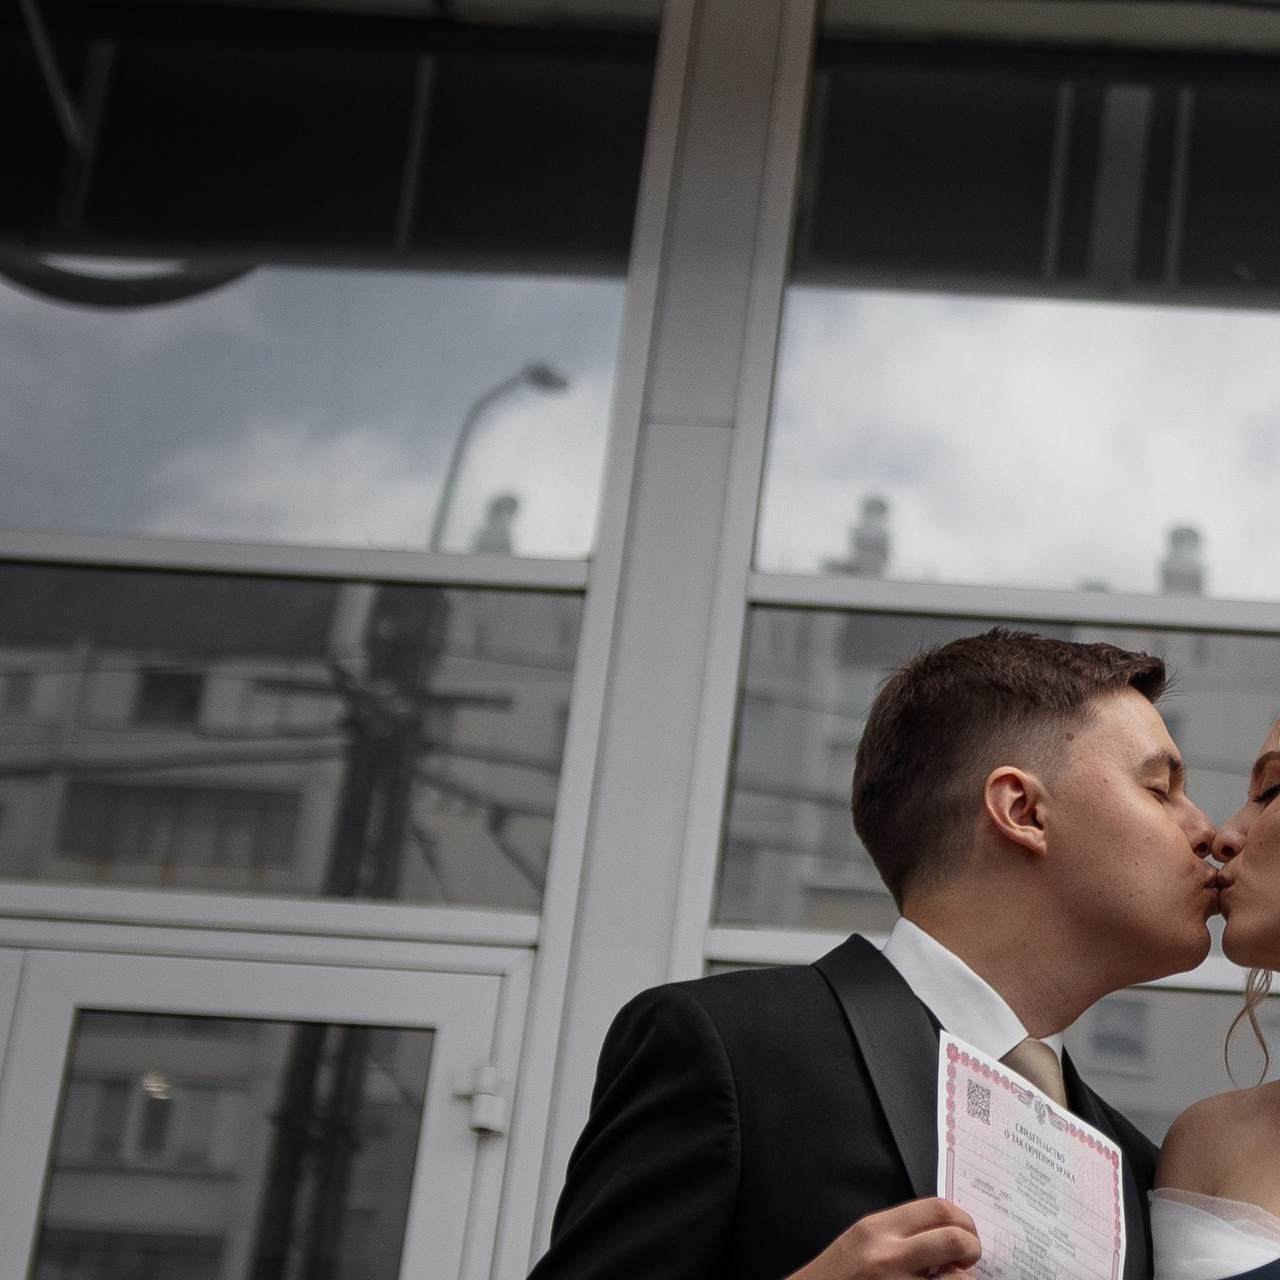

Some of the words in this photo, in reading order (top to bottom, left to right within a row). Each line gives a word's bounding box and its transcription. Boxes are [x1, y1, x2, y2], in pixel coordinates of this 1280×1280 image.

[1004, 1129, 1010, 1140] О
[1012, 1133, 1056, 1170] ЗАКЛЮЧЕНИИ
[1056, 1163, 1076, 1184] БРАКА
[1015, 1123, 1065, 1164] СВИДЕТЕЛЬСТВО
